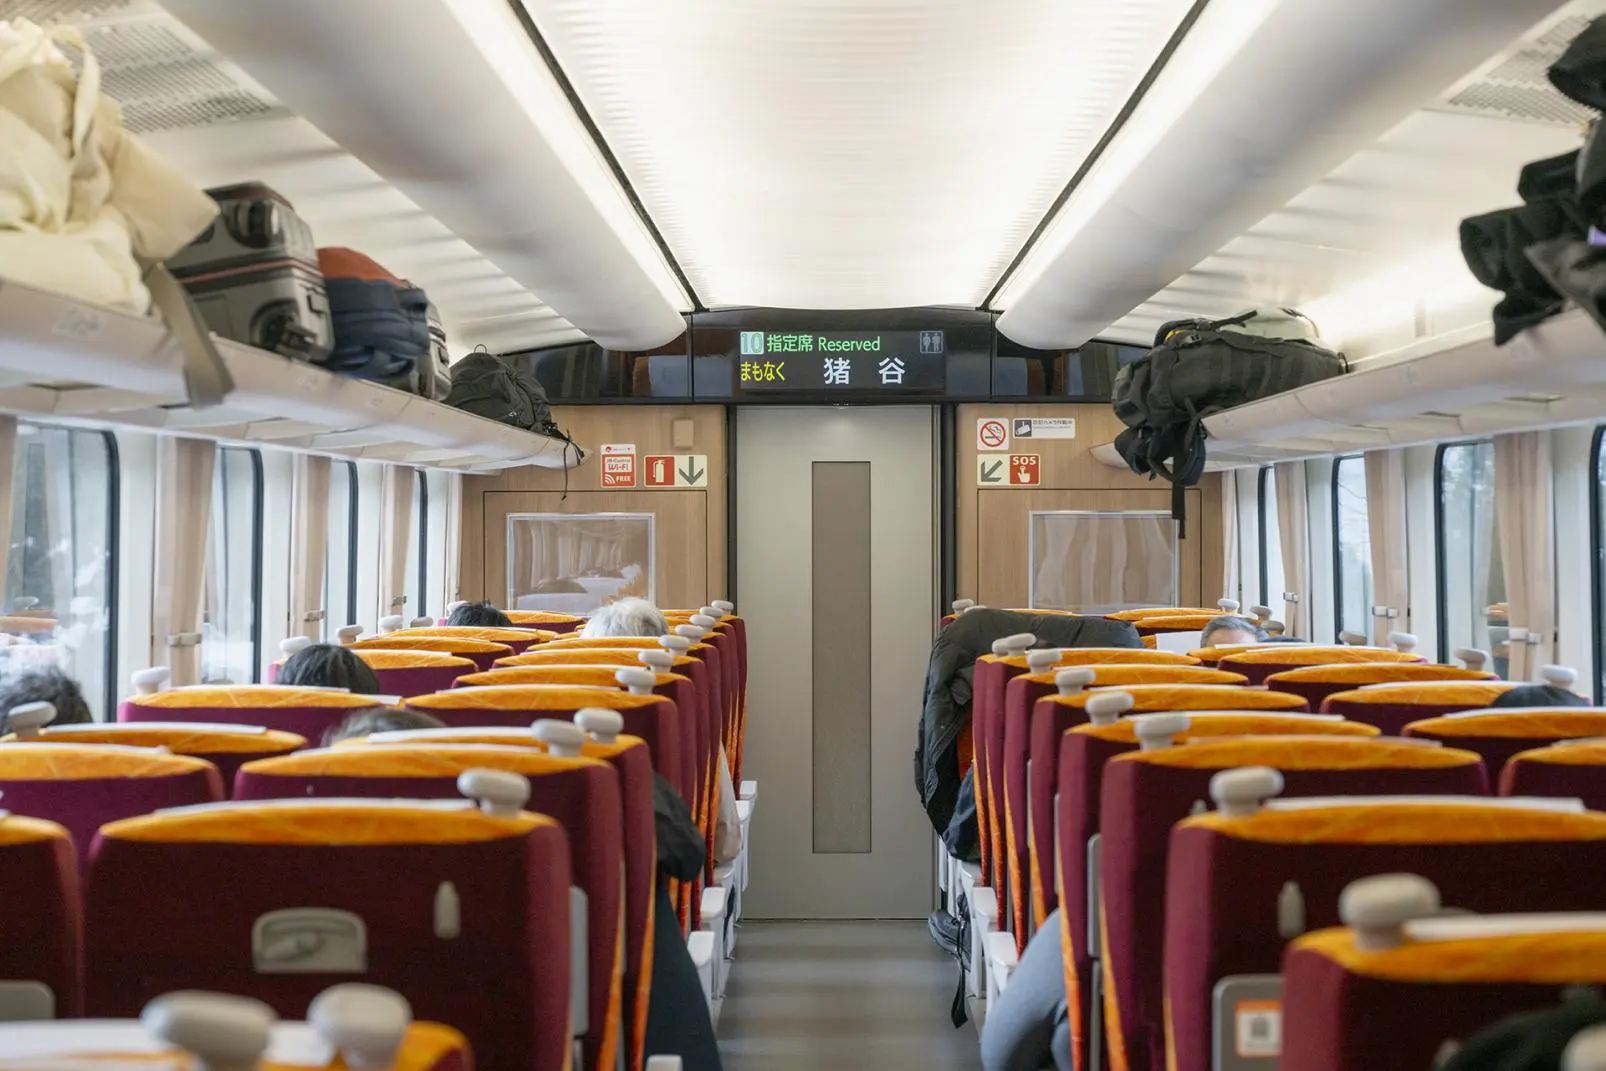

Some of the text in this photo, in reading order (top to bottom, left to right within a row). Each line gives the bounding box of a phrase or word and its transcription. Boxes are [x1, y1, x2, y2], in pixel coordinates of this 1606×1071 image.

[741, 333, 881, 353] 10 指定席 Reserved
[741, 361, 785, 381] まもなく
[1012, 456, 1037, 465] SOS
